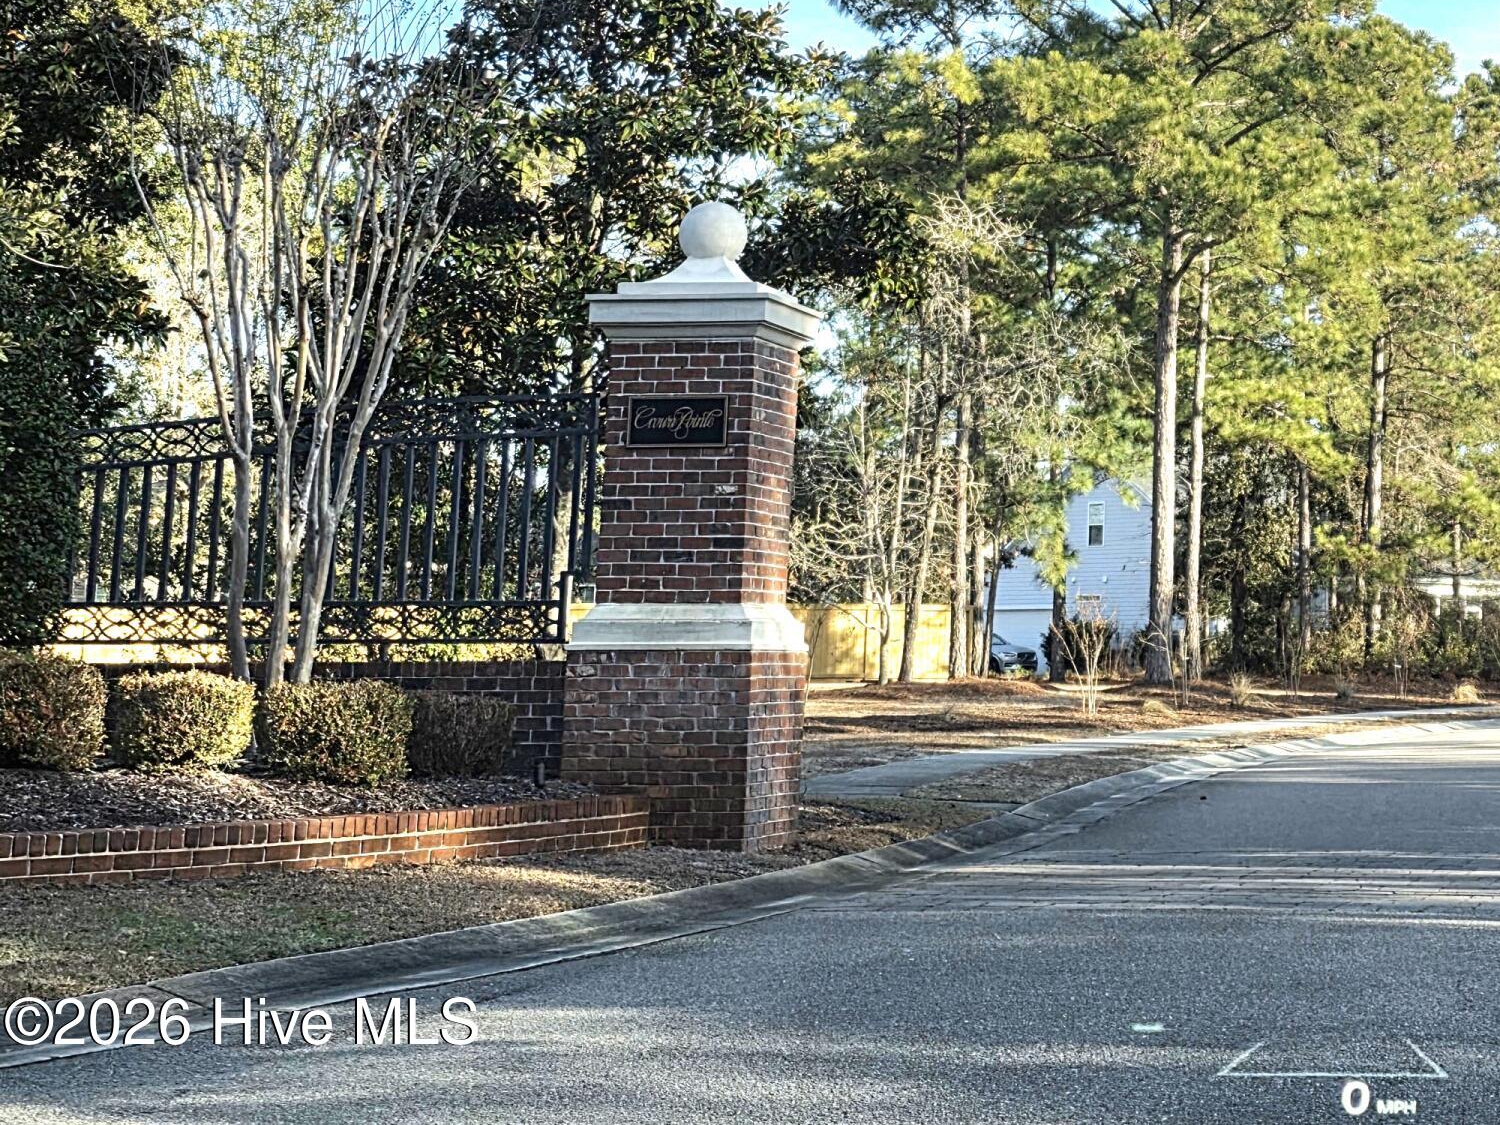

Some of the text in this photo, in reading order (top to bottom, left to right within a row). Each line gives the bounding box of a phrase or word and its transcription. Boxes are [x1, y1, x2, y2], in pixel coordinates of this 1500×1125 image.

[634, 406, 676, 429] Crown
[1341, 1080, 1418, 1116] 0 MPH
